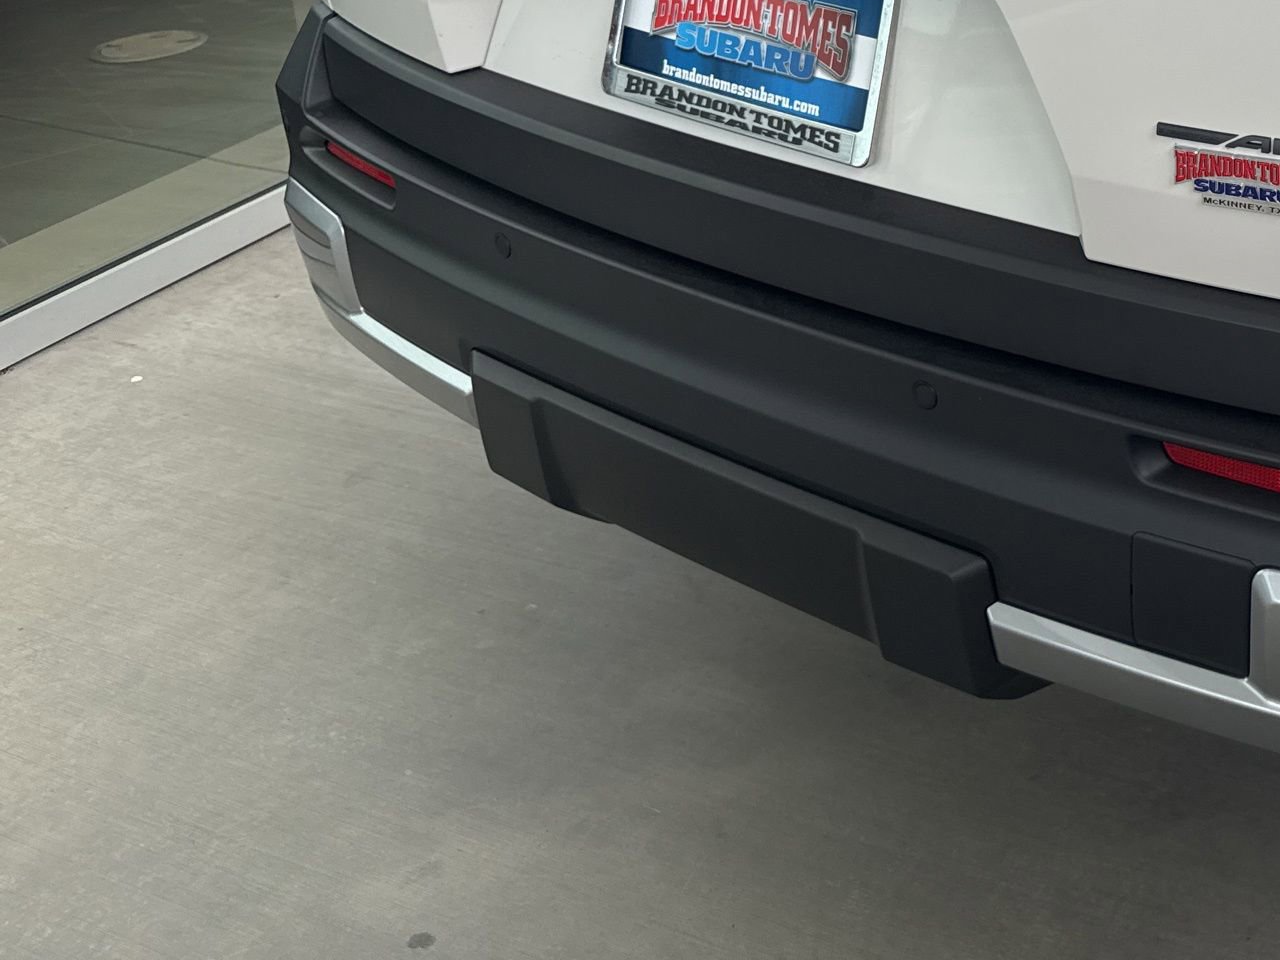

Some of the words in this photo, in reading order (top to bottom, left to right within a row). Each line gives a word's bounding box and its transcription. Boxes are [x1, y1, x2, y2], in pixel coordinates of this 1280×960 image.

[675, 22, 816, 80] SUBARU
[624, 74, 747, 119] BRANDON
[749, 110, 841, 153] TOMES
[662, 59, 820, 117] brandontomessubaru.com
[655, 97, 802, 145] SUBARU
[1175, 149, 1257, 182] BRANDON
